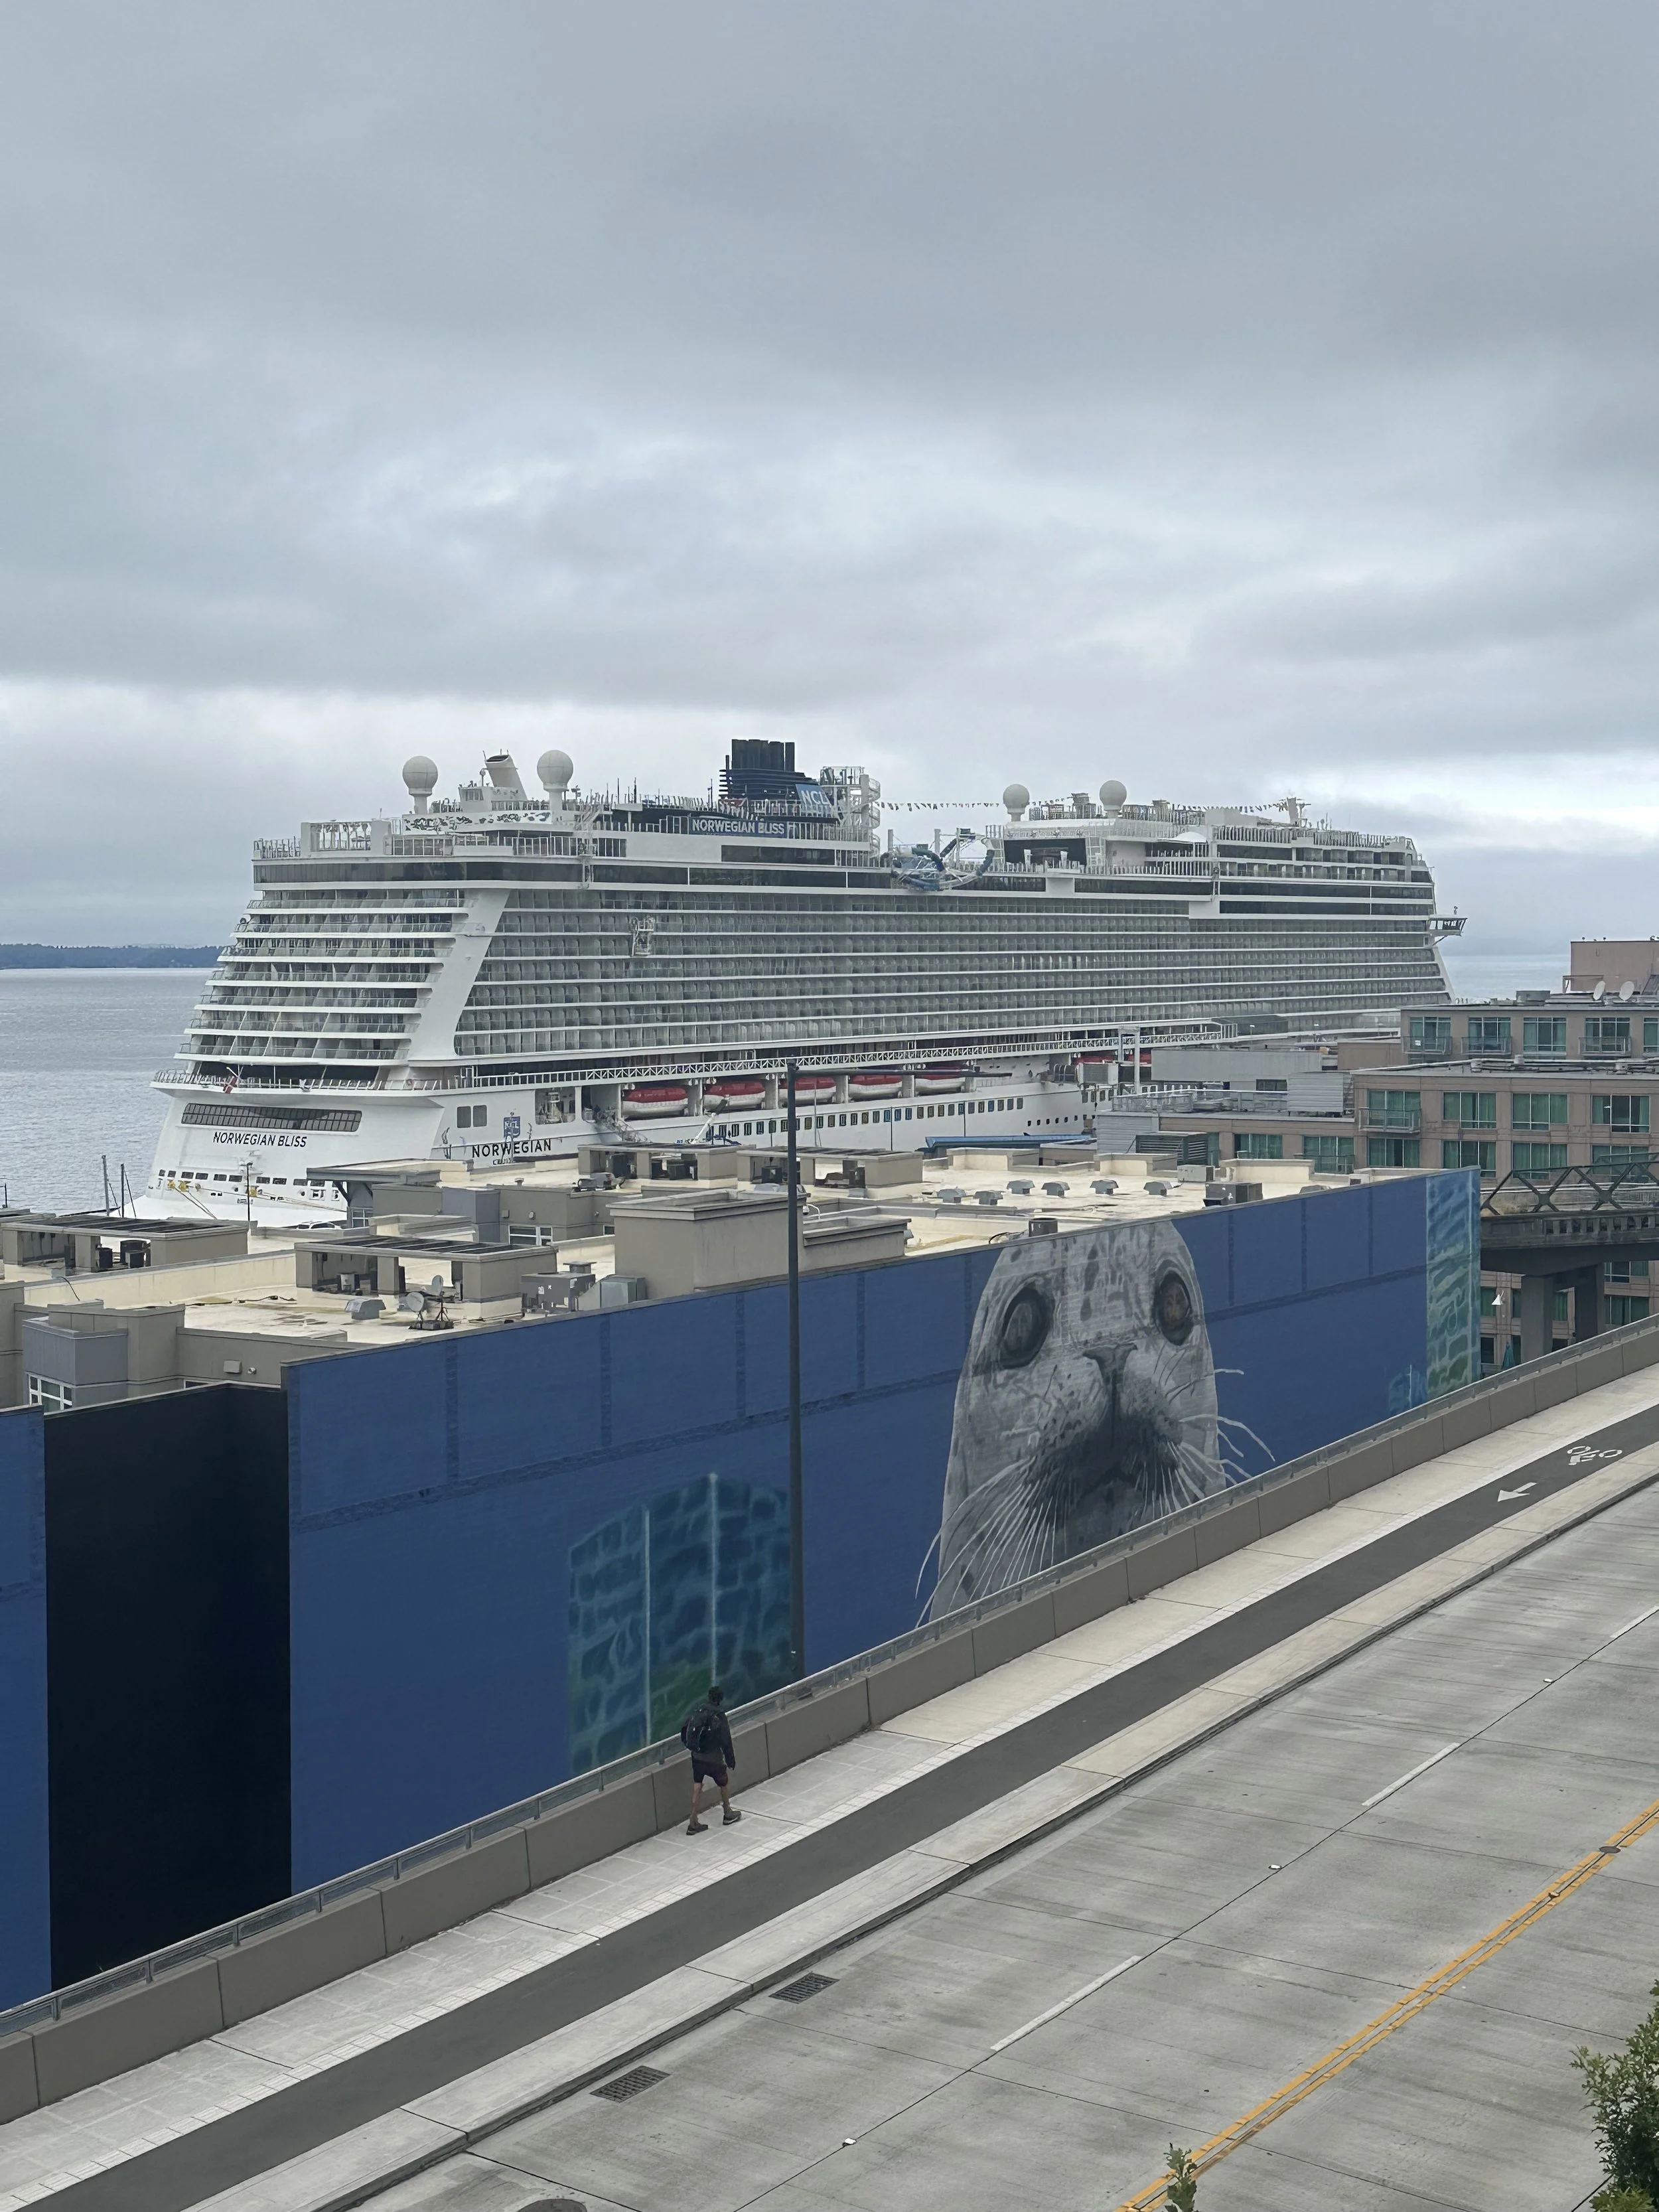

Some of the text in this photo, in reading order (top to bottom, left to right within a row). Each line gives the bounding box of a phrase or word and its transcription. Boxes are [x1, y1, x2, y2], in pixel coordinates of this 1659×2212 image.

[801, 790, 830, 806] NCL
[692, 819, 785, 834] NORWEGIAN BLISS
[213, 1132, 307, 1147] NORWEGIAN BLISS
[472, 1138, 551, 1158] NORWEGIAN
